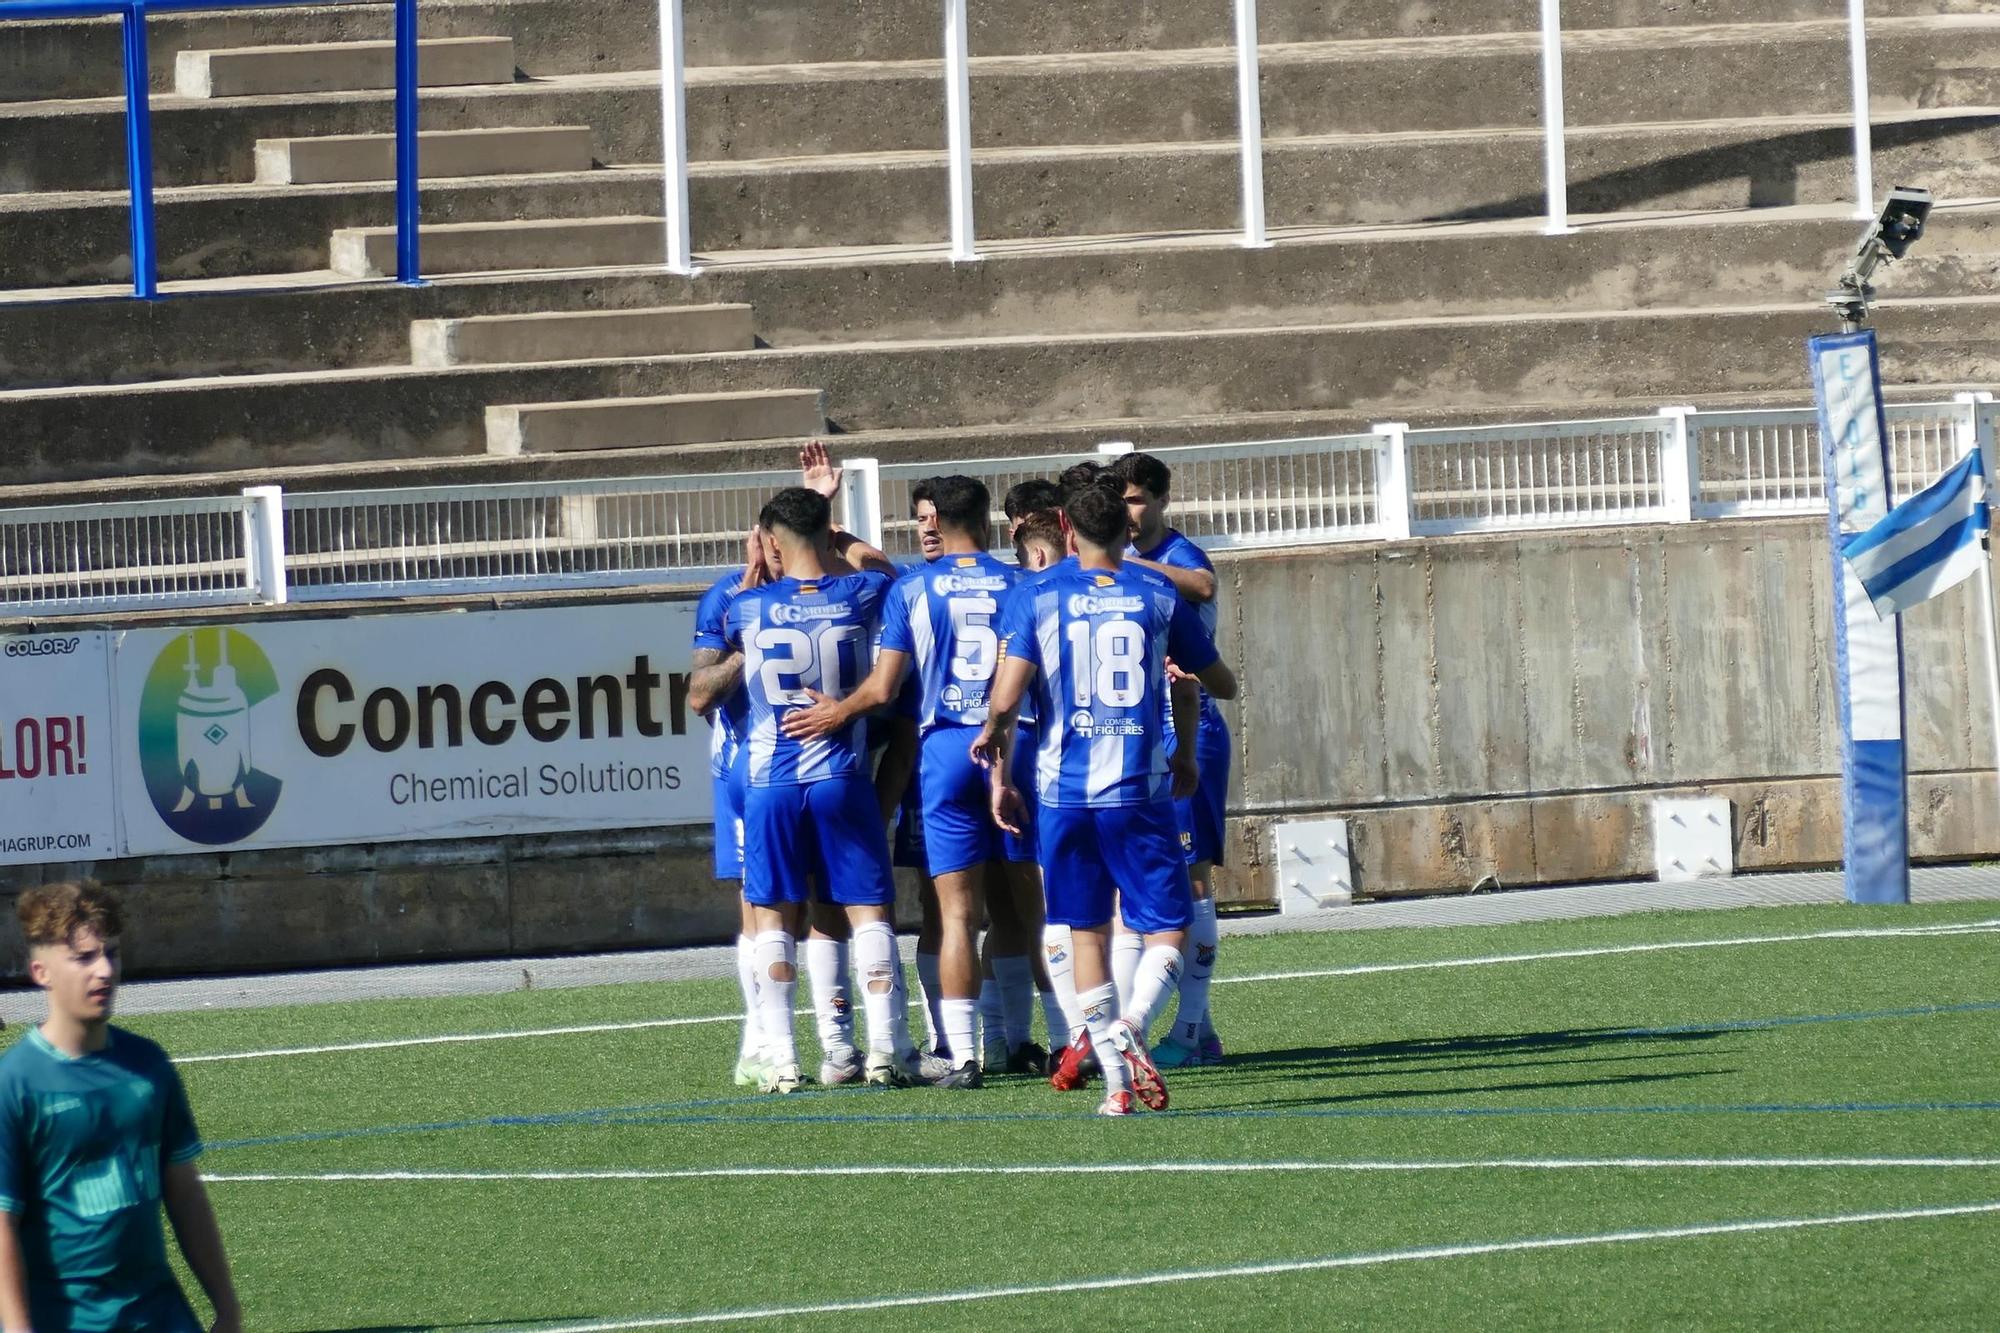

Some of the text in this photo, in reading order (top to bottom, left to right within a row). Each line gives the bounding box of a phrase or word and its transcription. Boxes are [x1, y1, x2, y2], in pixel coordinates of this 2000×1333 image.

[5, 638, 80, 657] COLORS
[754, 625, 870, 706] 20
[949, 597, 998, 682] 5
[1067, 619, 1146, 708] 18
[297, 655, 692, 758] Concentr
[1094, 725, 1145, 736] FIGUERES
[390, 761, 682, 805] Chemical Solutions
[0, 833, 91, 853] IAGRUP.COM
